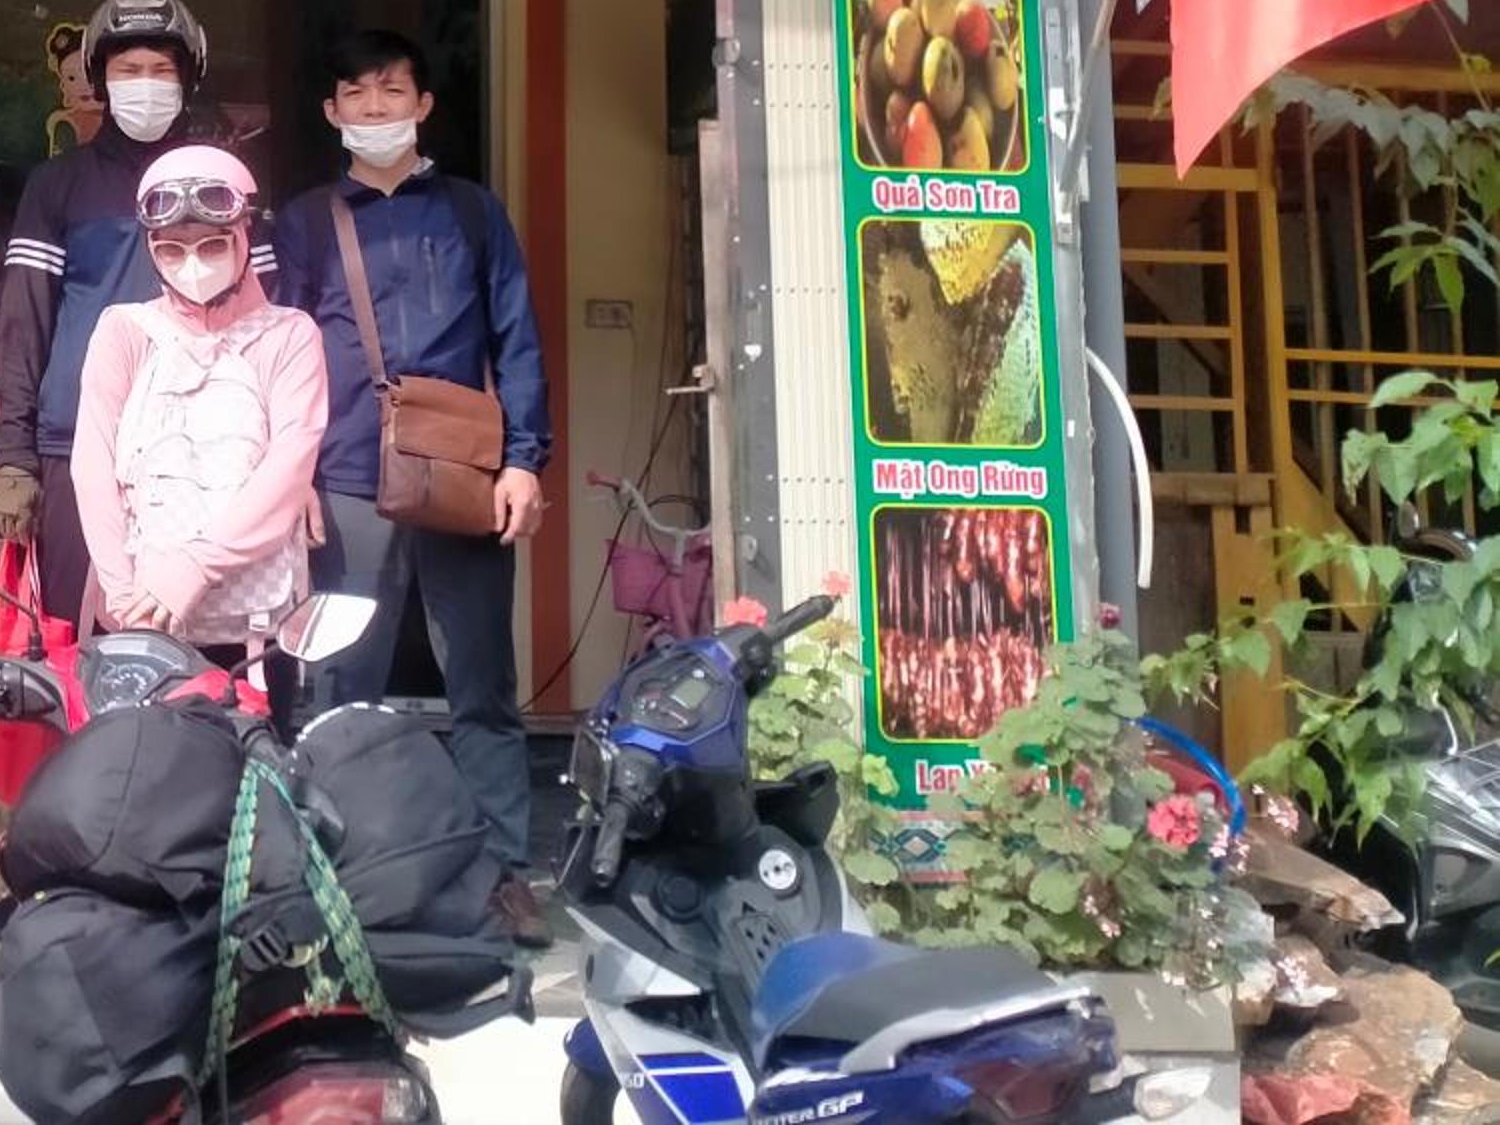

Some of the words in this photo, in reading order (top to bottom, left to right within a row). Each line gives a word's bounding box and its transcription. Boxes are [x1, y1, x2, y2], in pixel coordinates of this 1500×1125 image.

[872, 174, 924, 212] Quả
[977, 179, 1020, 213] Tra
[872, 459, 926, 499] Mật
[928, 459, 978, 499] Ong
